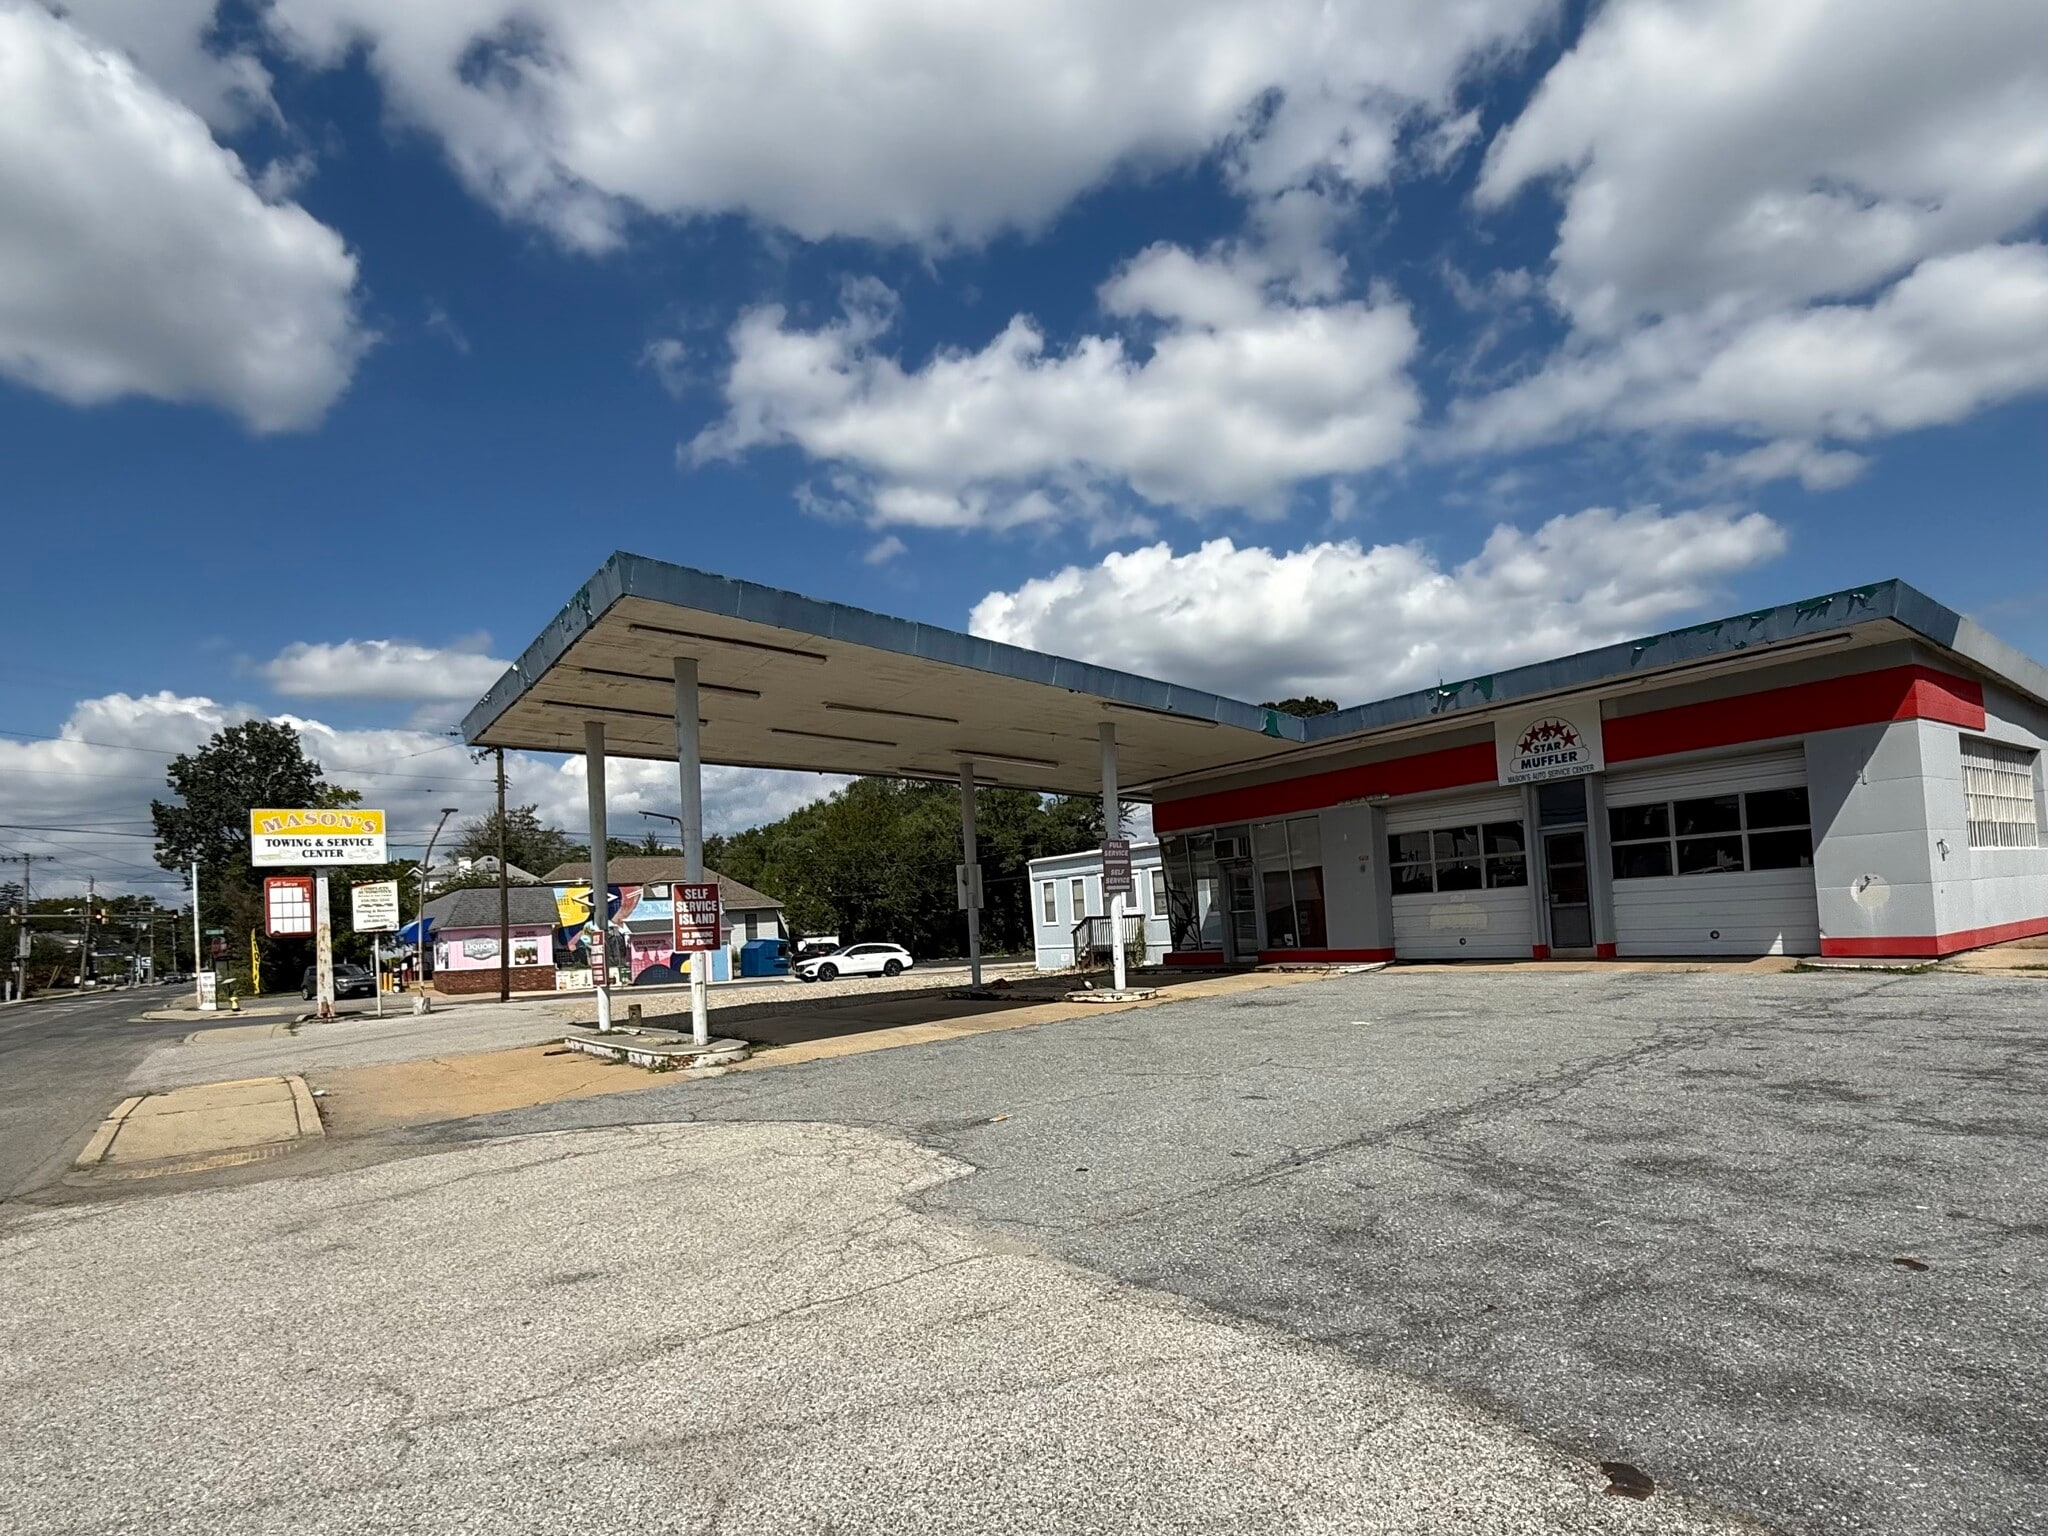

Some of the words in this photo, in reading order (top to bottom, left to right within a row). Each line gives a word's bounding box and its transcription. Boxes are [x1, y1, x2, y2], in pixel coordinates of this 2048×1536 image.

[1533, 742, 1561, 753] STAR
[1520, 751, 1578, 770] MUFFLER
[1507, 774, 1531, 783] MASON'S
[1548, 768, 1570, 776] SERVICE
[1572, 764, 1595, 773] CENTER
[261, 812, 377, 833] MASON'S
[265, 838, 312, 847] TOWING
[315, 838, 324, 847] &
[327, 838, 374, 847] SERVICE
[301, 849, 344, 858] CENTER
[684, 888, 709, 900] SELF
[675, 900, 717, 913] SERVICE
[678, 913, 715, 925] ISLAND
